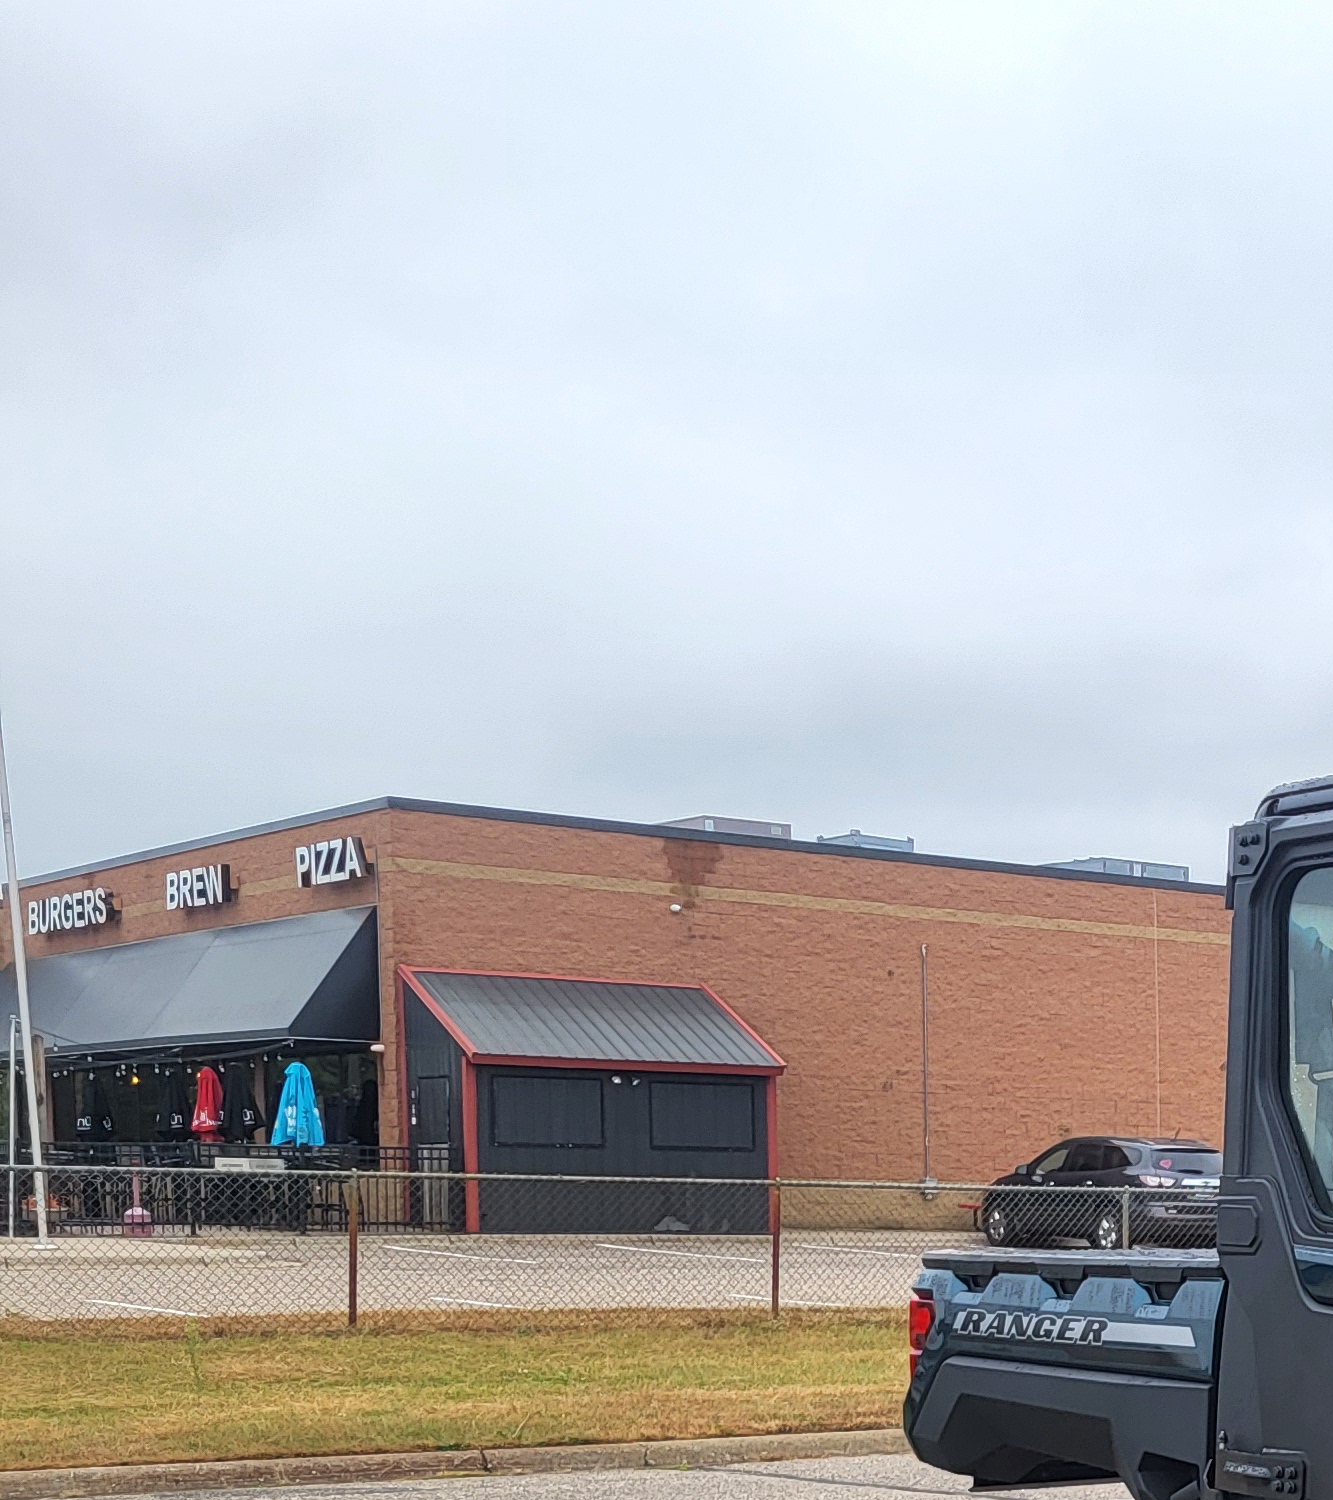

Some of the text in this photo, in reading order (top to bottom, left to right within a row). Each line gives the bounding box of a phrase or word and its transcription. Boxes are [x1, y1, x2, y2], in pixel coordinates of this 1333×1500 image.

[295, 836, 362, 888] PIZZA
[28, 887, 107, 935] BURGERS
[166, 863, 223, 911] BREW
[959, 1308, 1108, 1346] RANGER
